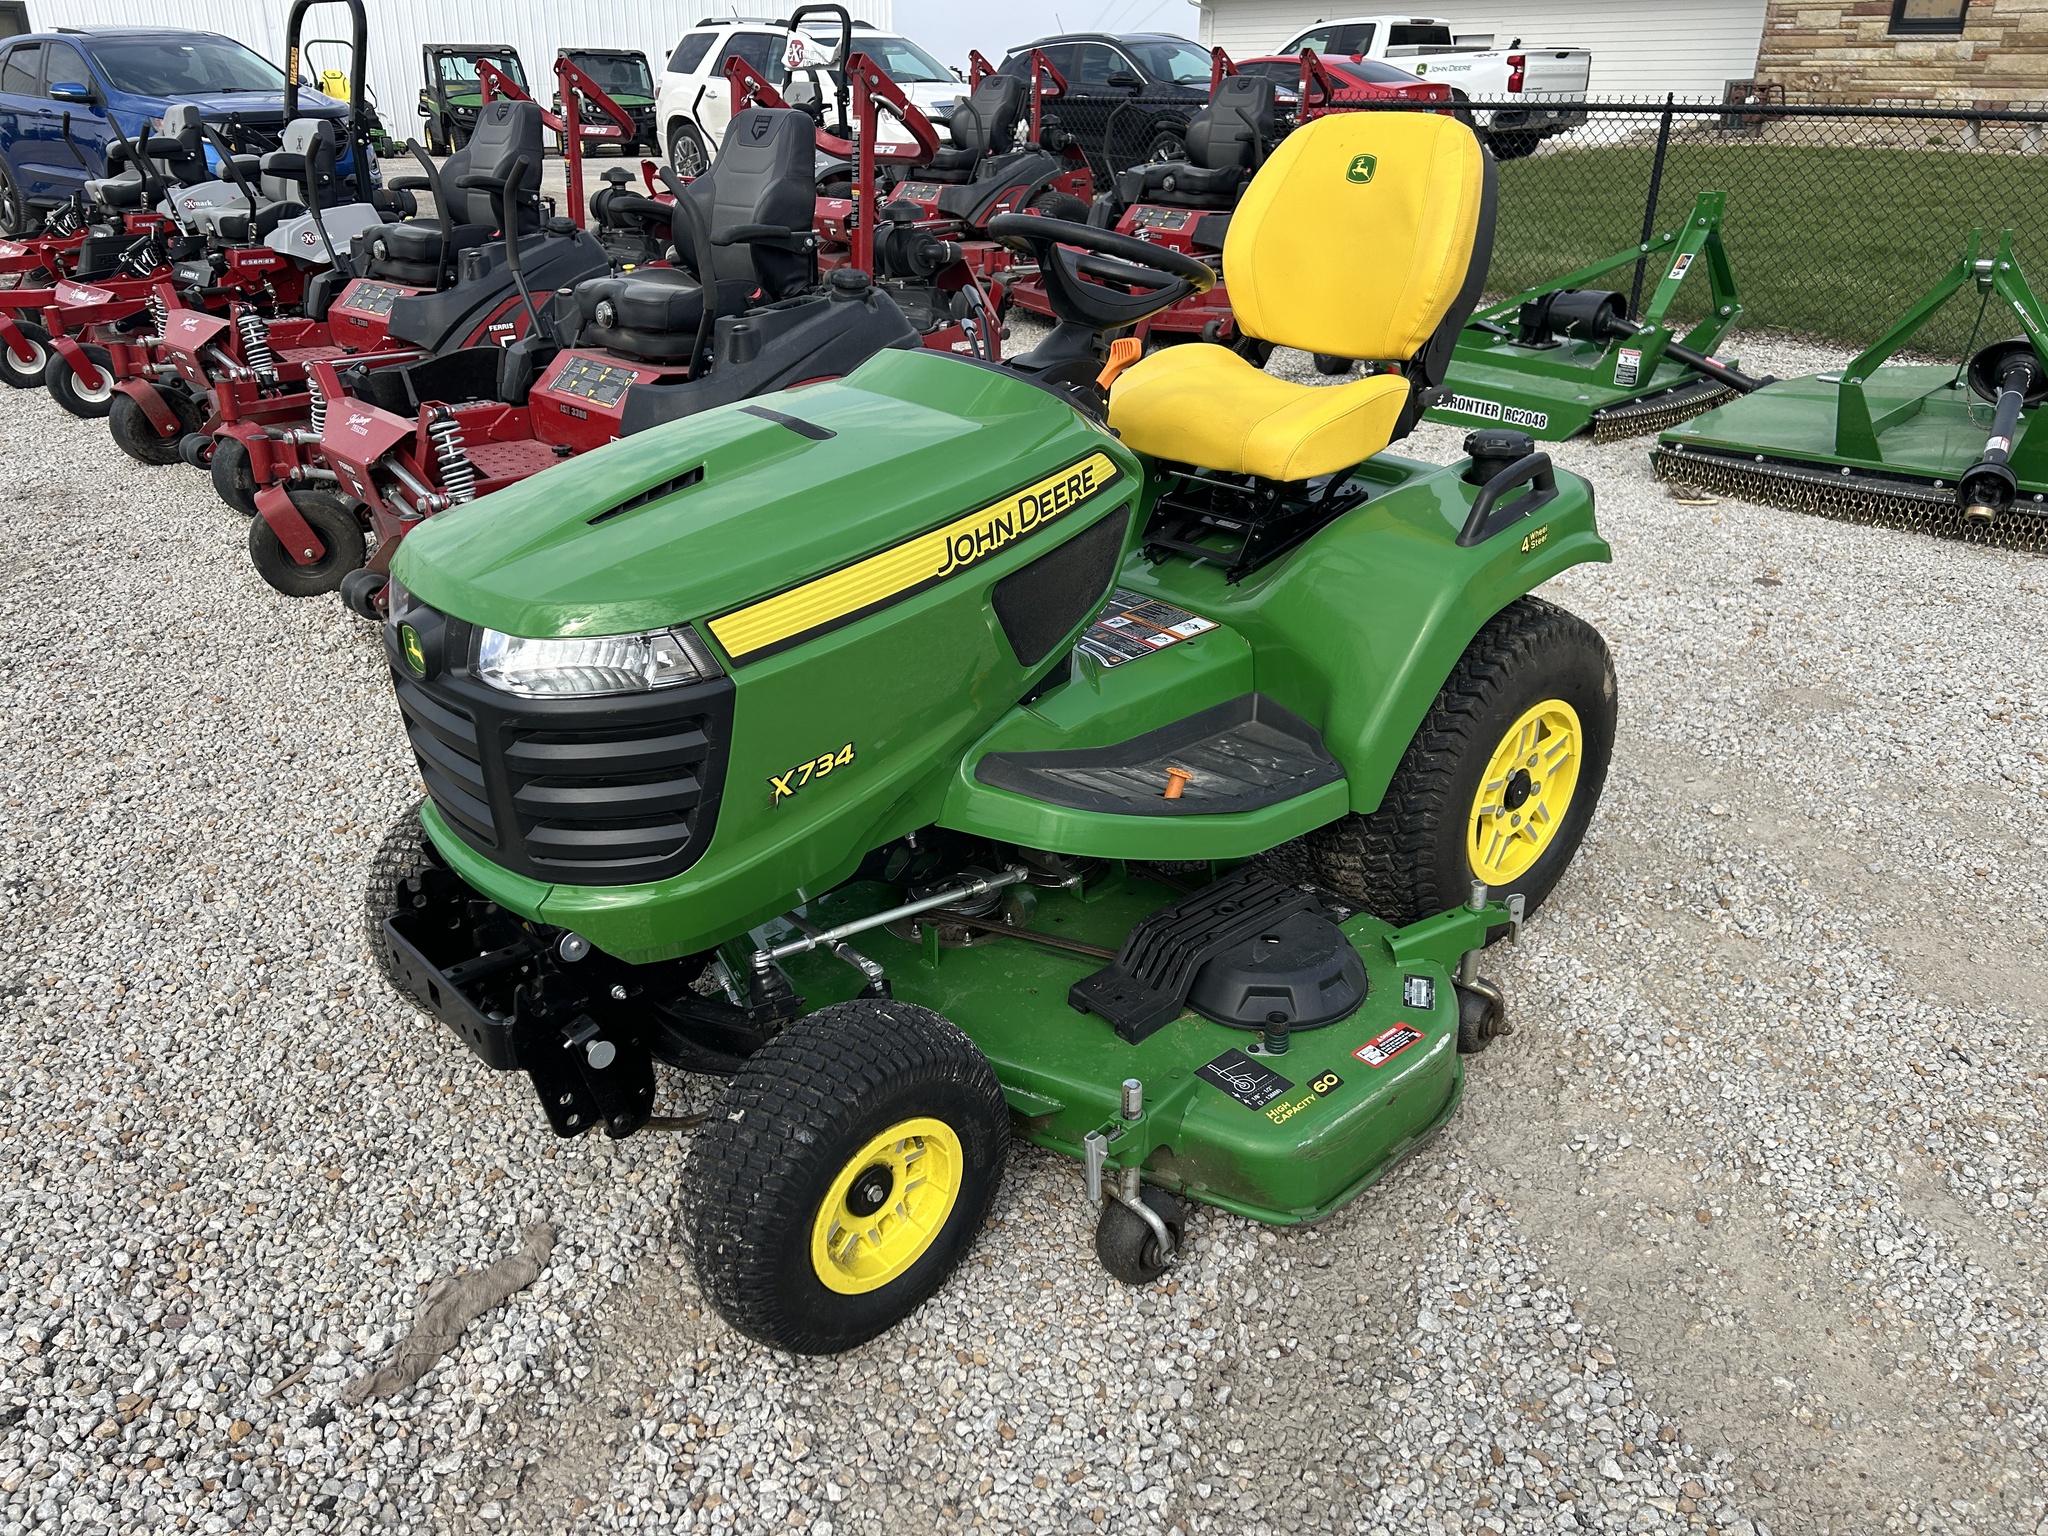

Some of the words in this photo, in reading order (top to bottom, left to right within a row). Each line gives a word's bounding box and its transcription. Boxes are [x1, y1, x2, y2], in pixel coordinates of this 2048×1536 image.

[184, 200, 212, 209] eXmark
[301, 233, 333, 244] eXmak
[489, 322, 514, 331] FERRIS
[1442, 396, 1500, 418] RONTIER
[1504, 408, 1546, 428] RC2048
[937, 511, 1014, 574] JOHN
[1018, 464, 1096, 530] DEERE
[1521, 536, 1530, 552] 4
[1530, 524, 1548, 540] Wheel
[1530, 534, 1548, 549] Steer
[768, 742, 855, 800] X734
[1313, 1073, 1339, 1093] 60
[1266, 1101, 1291, 1120] HIGH
[1273, 1093, 1317, 1125] CAPACITY
